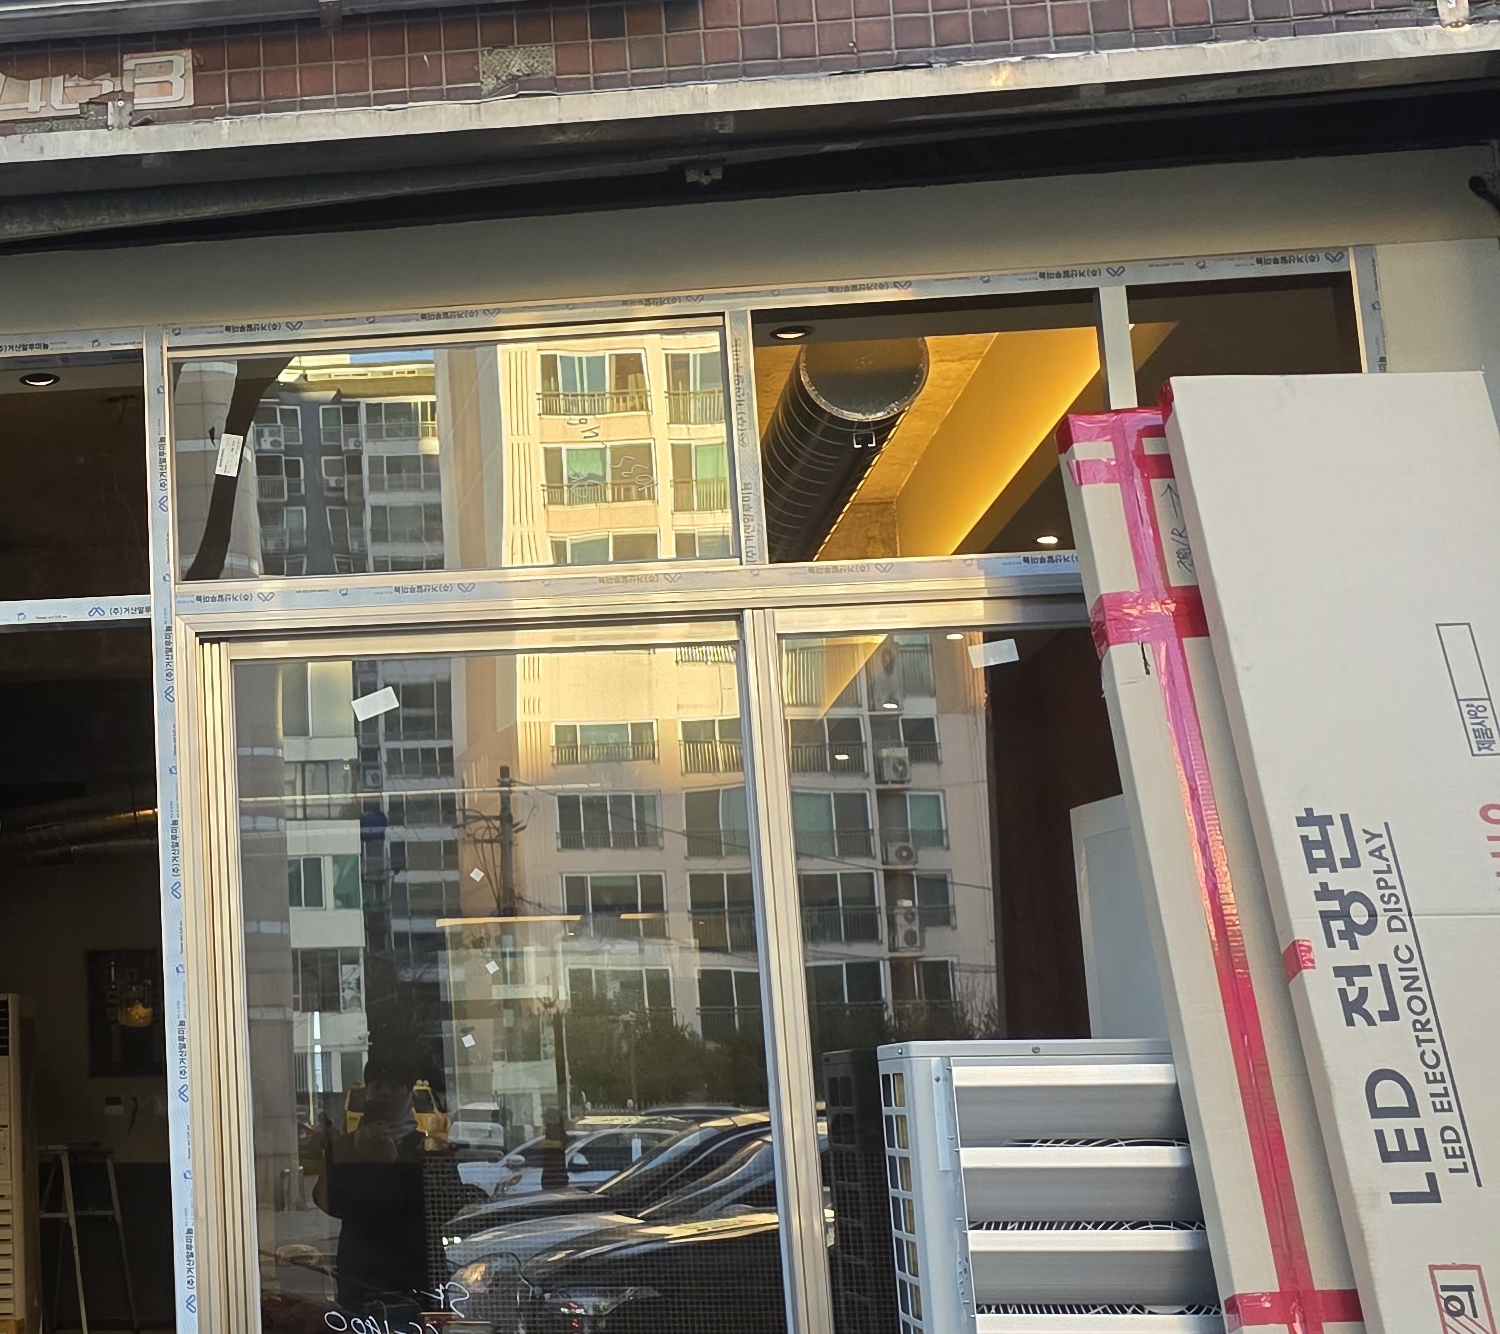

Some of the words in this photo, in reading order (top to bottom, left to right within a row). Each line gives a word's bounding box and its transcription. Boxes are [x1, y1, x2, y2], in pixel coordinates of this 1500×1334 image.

[1465, 703, 1495, 752] 제품사양
[1295, 807, 1401, 1027] 전광판
[1362, 828, 1407, 933] DISPLAY
[1393, 943, 1454, 1114] ELECTRONIC
[1365, 1068, 1442, 1204] LED
[1441, 1124, 1469, 1174] LED
